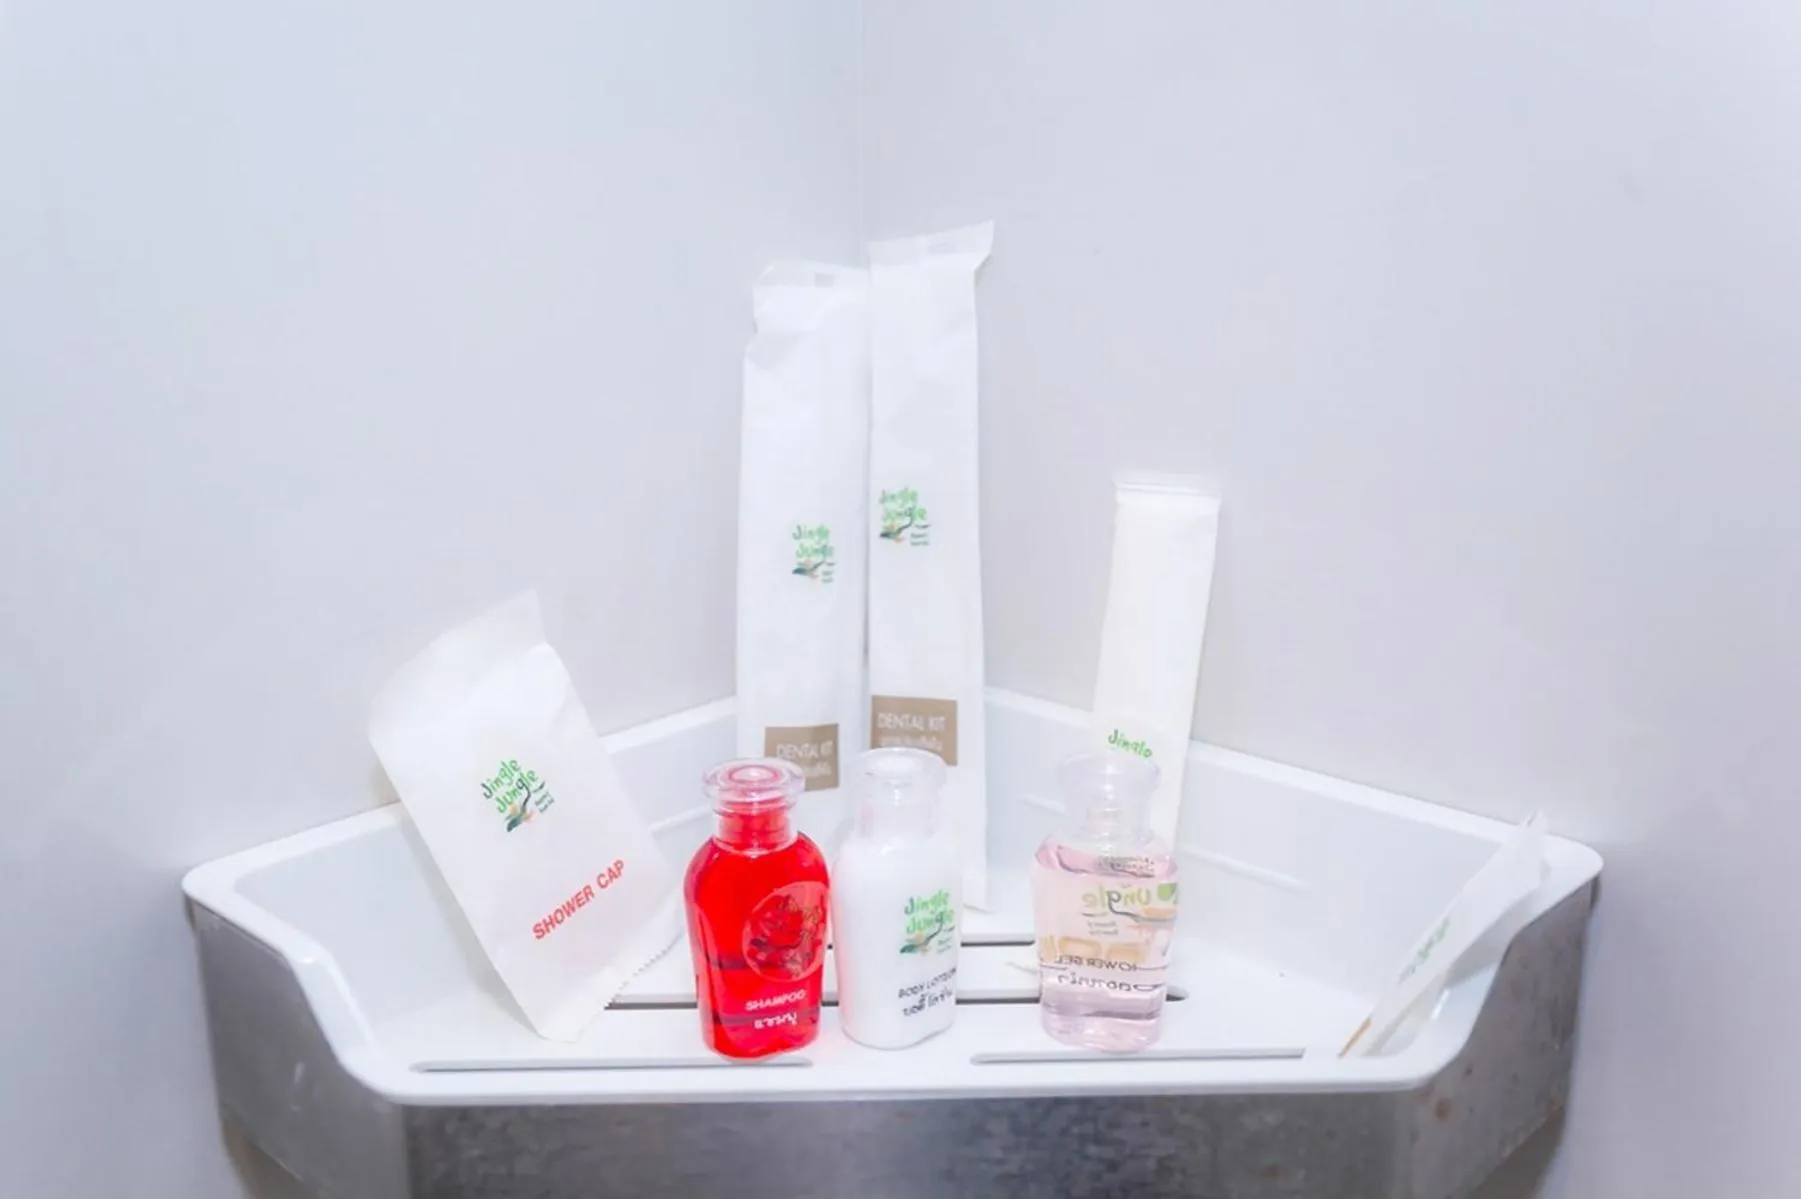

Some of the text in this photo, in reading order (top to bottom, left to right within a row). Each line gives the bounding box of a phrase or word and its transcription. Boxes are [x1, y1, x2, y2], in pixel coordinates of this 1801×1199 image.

[876, 711, 925, 731] DENTAL
[479, 759, 521, 799] Jingle
[495, 769, 539, 814] Jungle
[531, 858, 625, 940] SHOWER CAP
[903, 889, 951, 915] Jingle
[905, 908, 956, 935] Jungle
[744, 988, 807, 1012] SHAMPOO
[897, 982, 926, 999] BODY
